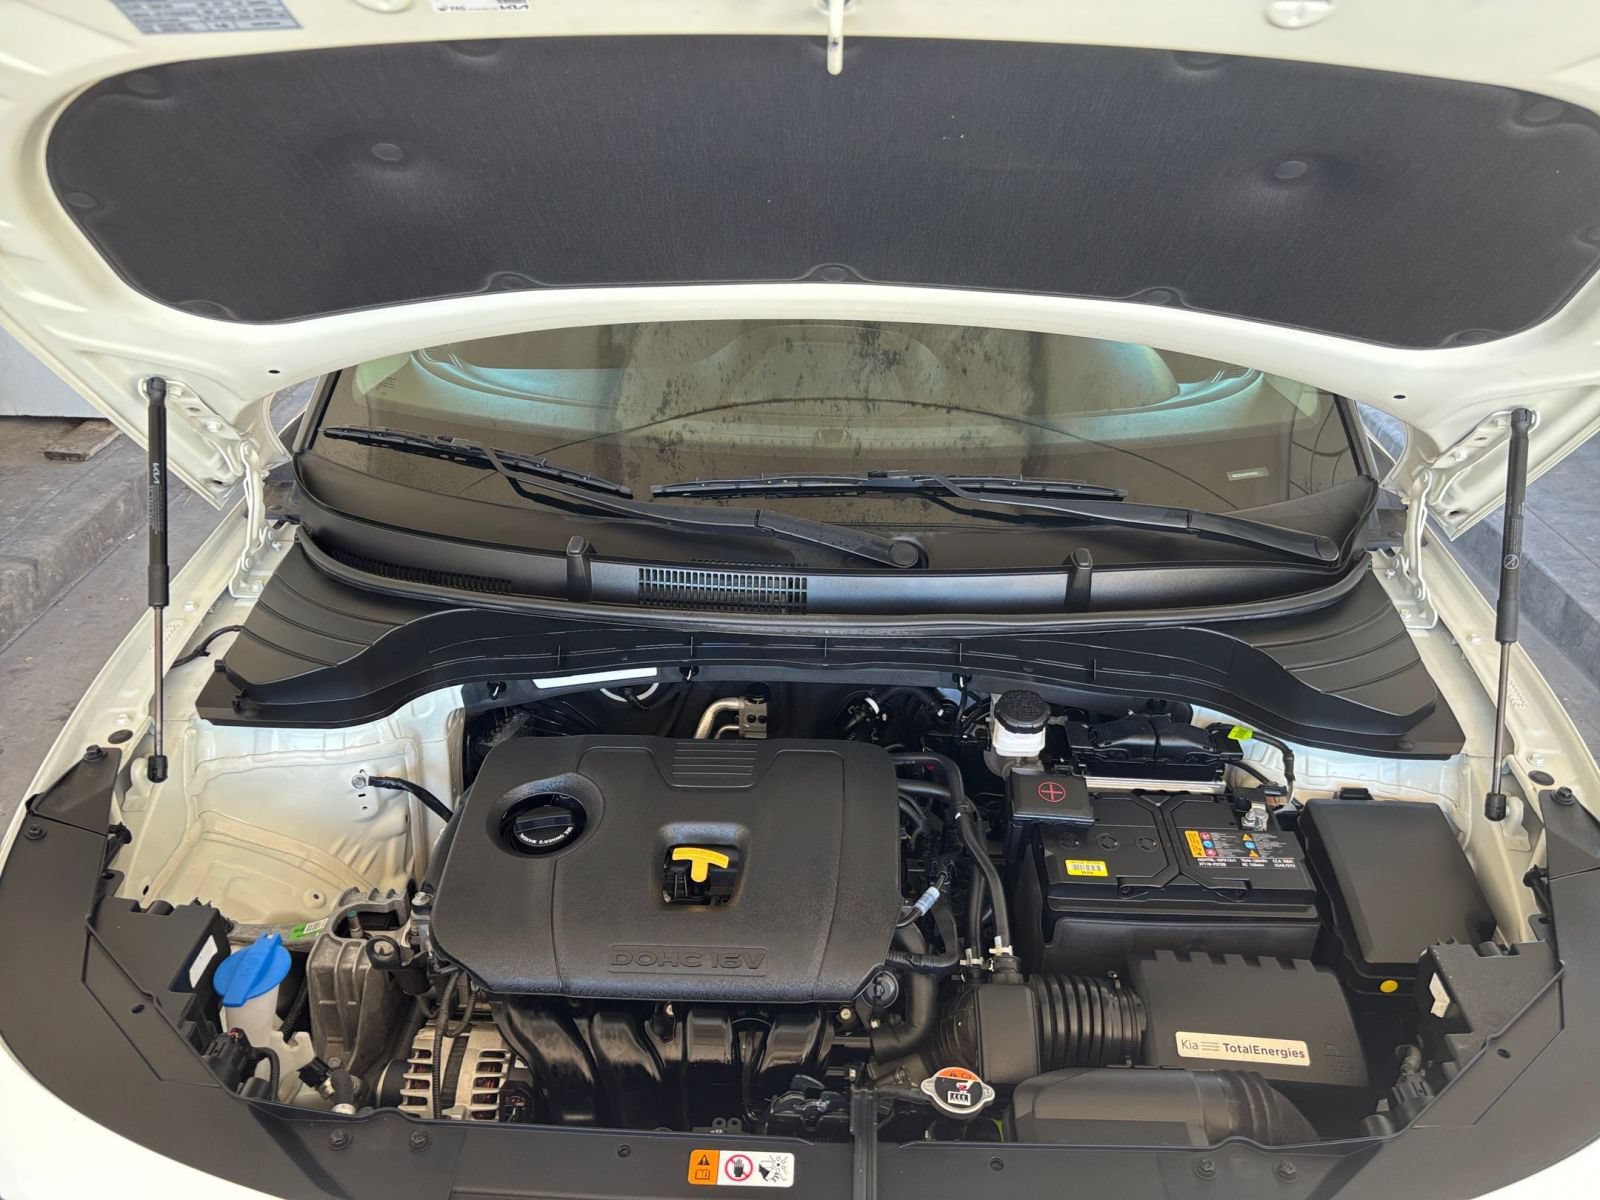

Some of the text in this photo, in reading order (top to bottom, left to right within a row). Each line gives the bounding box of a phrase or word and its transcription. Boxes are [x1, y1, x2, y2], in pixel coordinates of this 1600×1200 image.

[610, 950, 766, 970] DOHC 16V
[1181, 1039, 1306, 1059] Kia TotalEnergies
